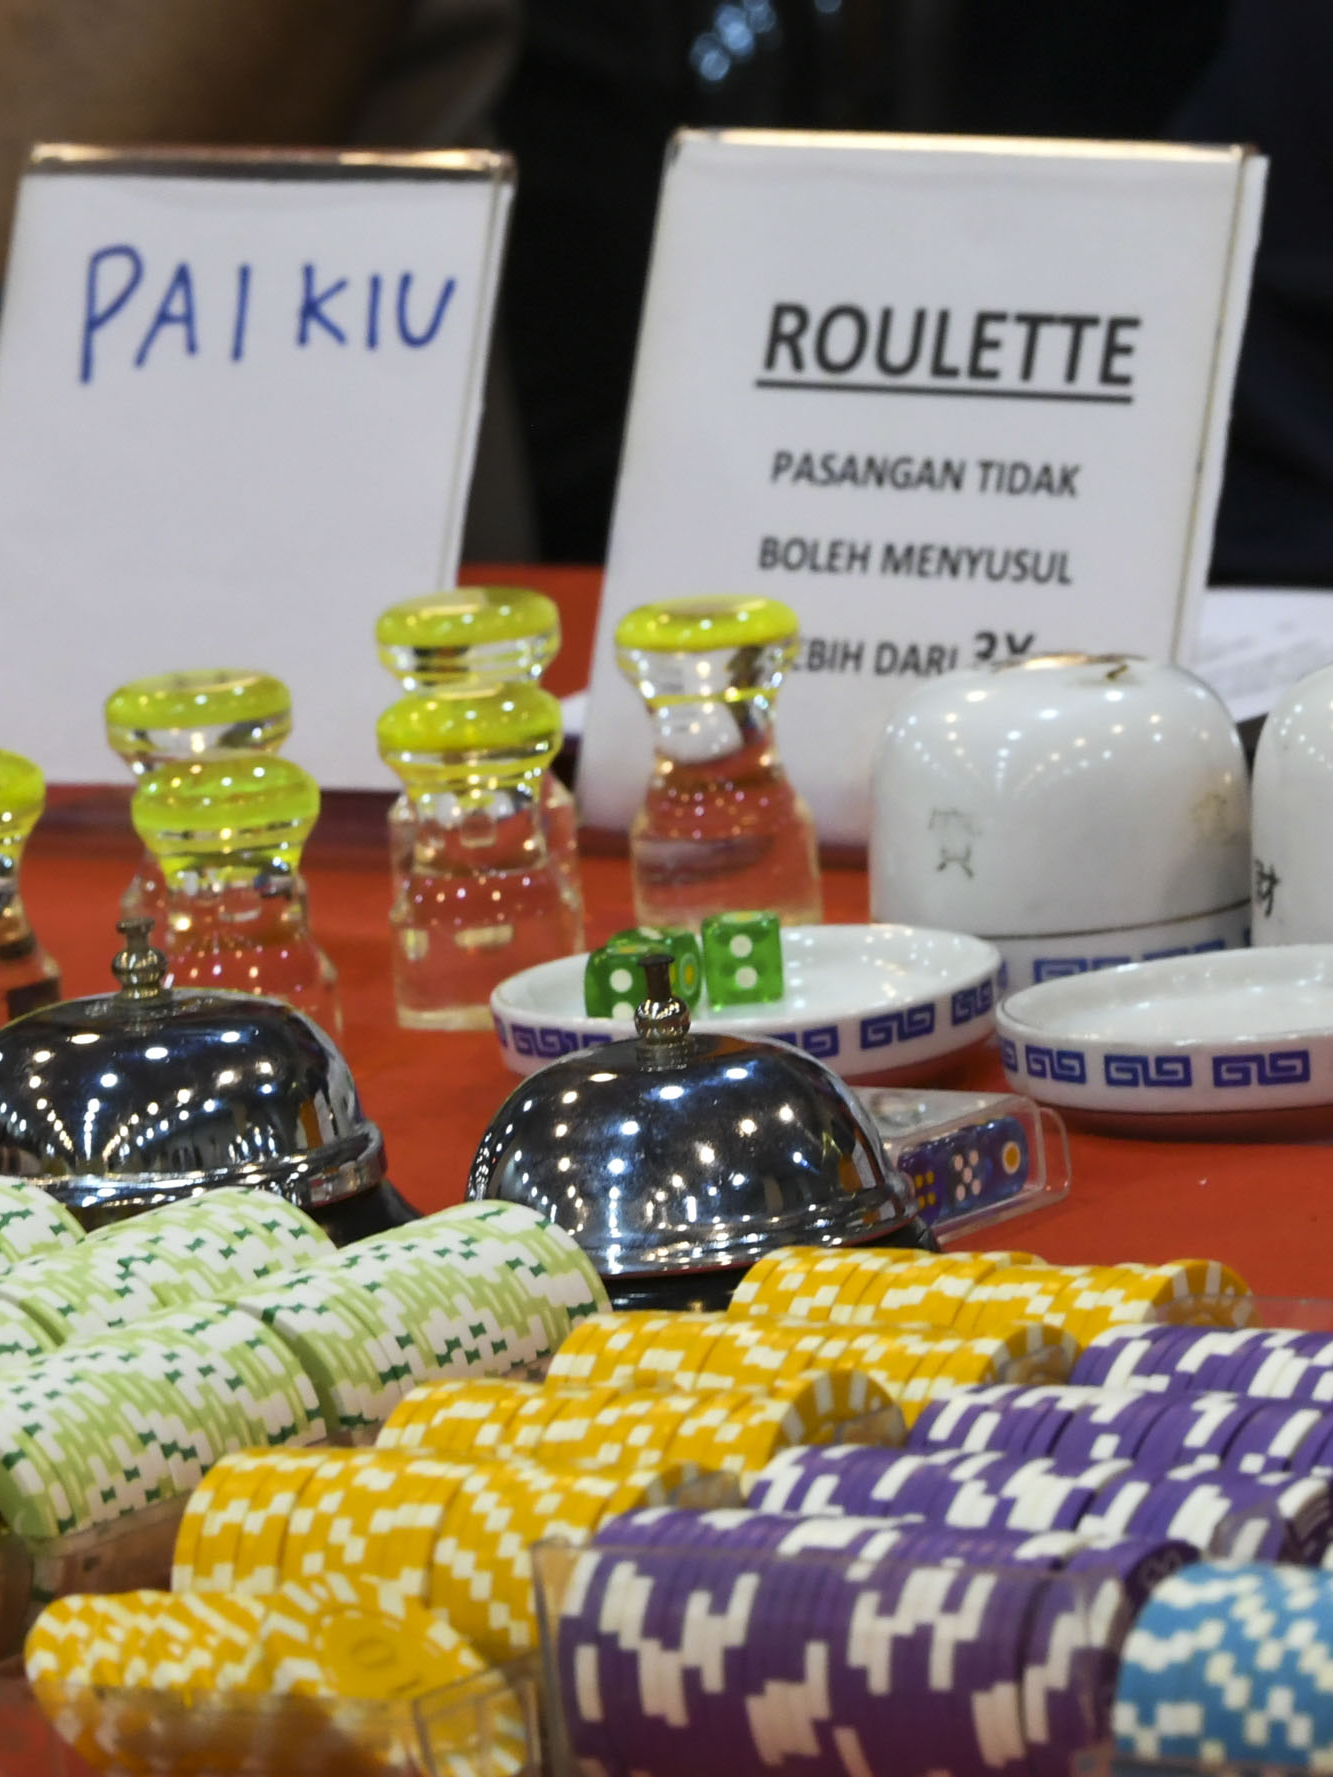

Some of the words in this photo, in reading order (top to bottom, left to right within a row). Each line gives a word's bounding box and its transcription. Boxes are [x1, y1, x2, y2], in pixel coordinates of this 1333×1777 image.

[79, 244, 251, 384] PAI
[296, 262, 456, 351] KIU
[763, 303, 1142, 386] ROULETTE
[770, 450, 966, 492] PASANGAN
[977, 459, 1080, 497] TIDAK
[758, 536, 871, 574] BOLEH
[880, 542, 1072, 585] MENYUSUL
[787, 637, 865, 674] BIH
[874, 640, 960, 677] DARI
